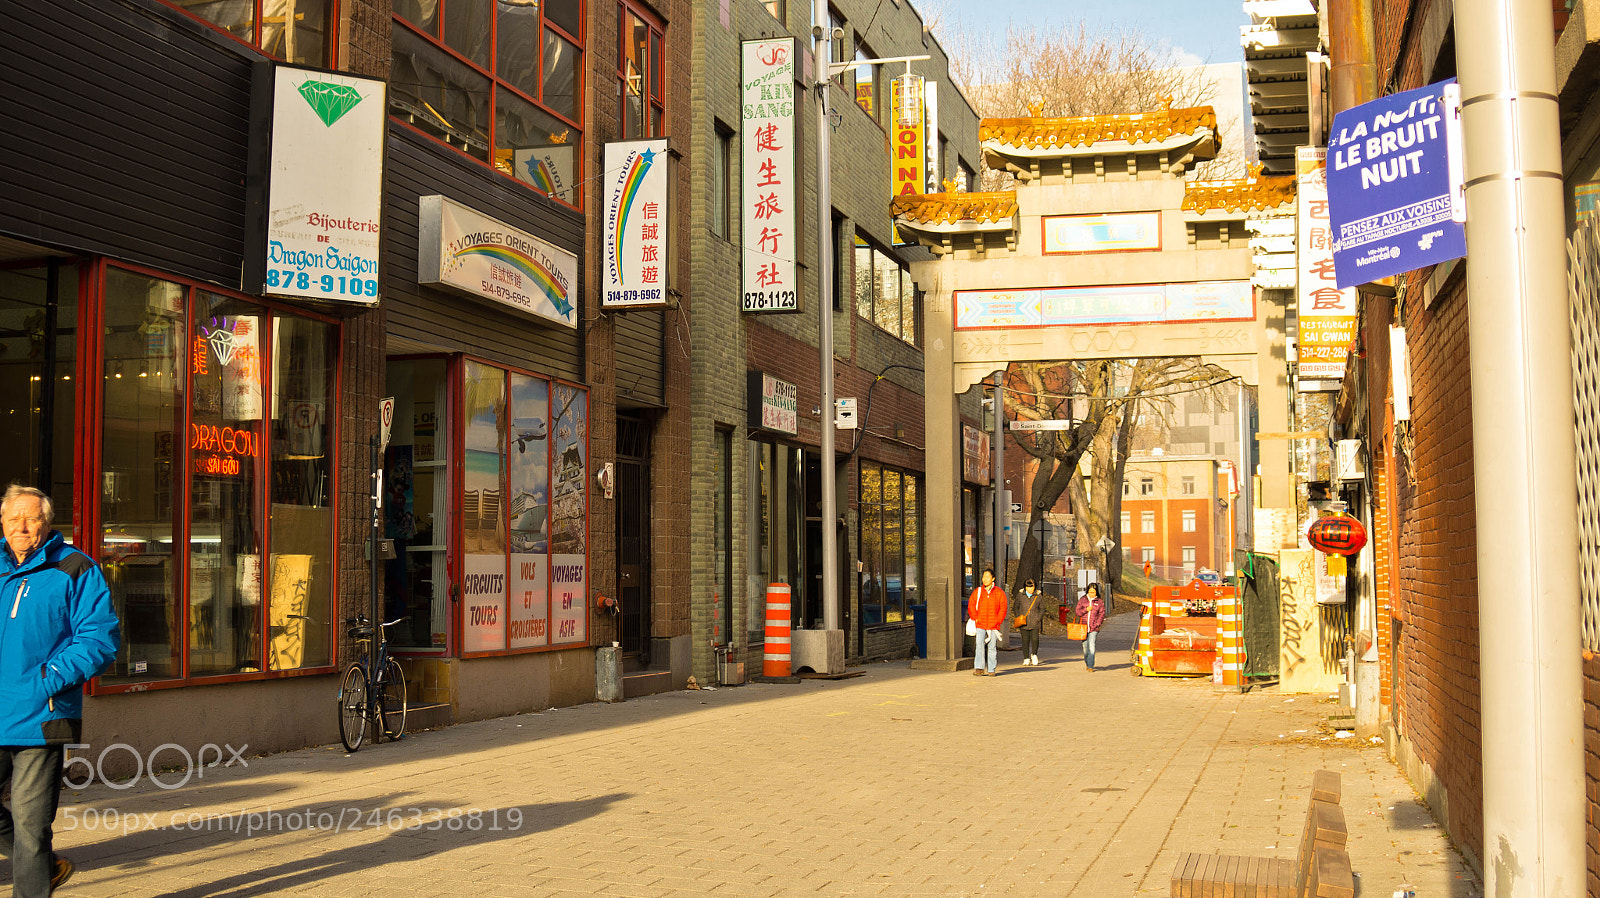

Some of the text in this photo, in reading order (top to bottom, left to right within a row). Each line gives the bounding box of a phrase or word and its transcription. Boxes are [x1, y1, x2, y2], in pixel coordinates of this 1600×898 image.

[745, 63, 791, 91] VOYAGE
[760, 83, 792, 101] KIN
[744, 101, 793, 120] SANG
[1335, 115, 1441, 171] LE BRUIT
[1339, 121, 1368, 146] LA
[1361, 150, 1424, 190] NUIT
[754, 122, 785, 288] 健生旅行社
[306, 212, 379, 233] Bijouterie
[608, 149, 637, 285] VOYAGES ORIENT TOURS
[1341, 218, 1380, 238] PENSEZ
[1382, 211, 1405, 227] AUX
[1407, 197, 1451, 219] VOISINS
[317, 234, 330, 243] DE
[641, 201, 659, 284] 信誠旅遊
[267, 240, 378, 277] Dragon Saigon
[457, 232, 569, 291] VOYAGES ORIENT TOURS
[266, 269, 378, 297] 878-9109
[481, 280, 531, 307] 514-879-6962
[607, 289, 661, 302] 514-879-6962
[744, 291, 795, 309] 878-1123
[1300, 320, 1354, 329] RESTAURANT
[1304, 331, 1351, 342] SAI GWAN
[520, 562, 536, 580] VOLS
[552, 565, 583, 583] VOYAGES
[464, 573, 504, 595] CIRCUITS
[524, 591, 532, 609] ET
[562, 592, 573, 610] EN
[470, 605, 498, 627] TOURS
[510, 614, 546, 640] CROISIÈRES
[559, 620, 576, 638] ASIE
